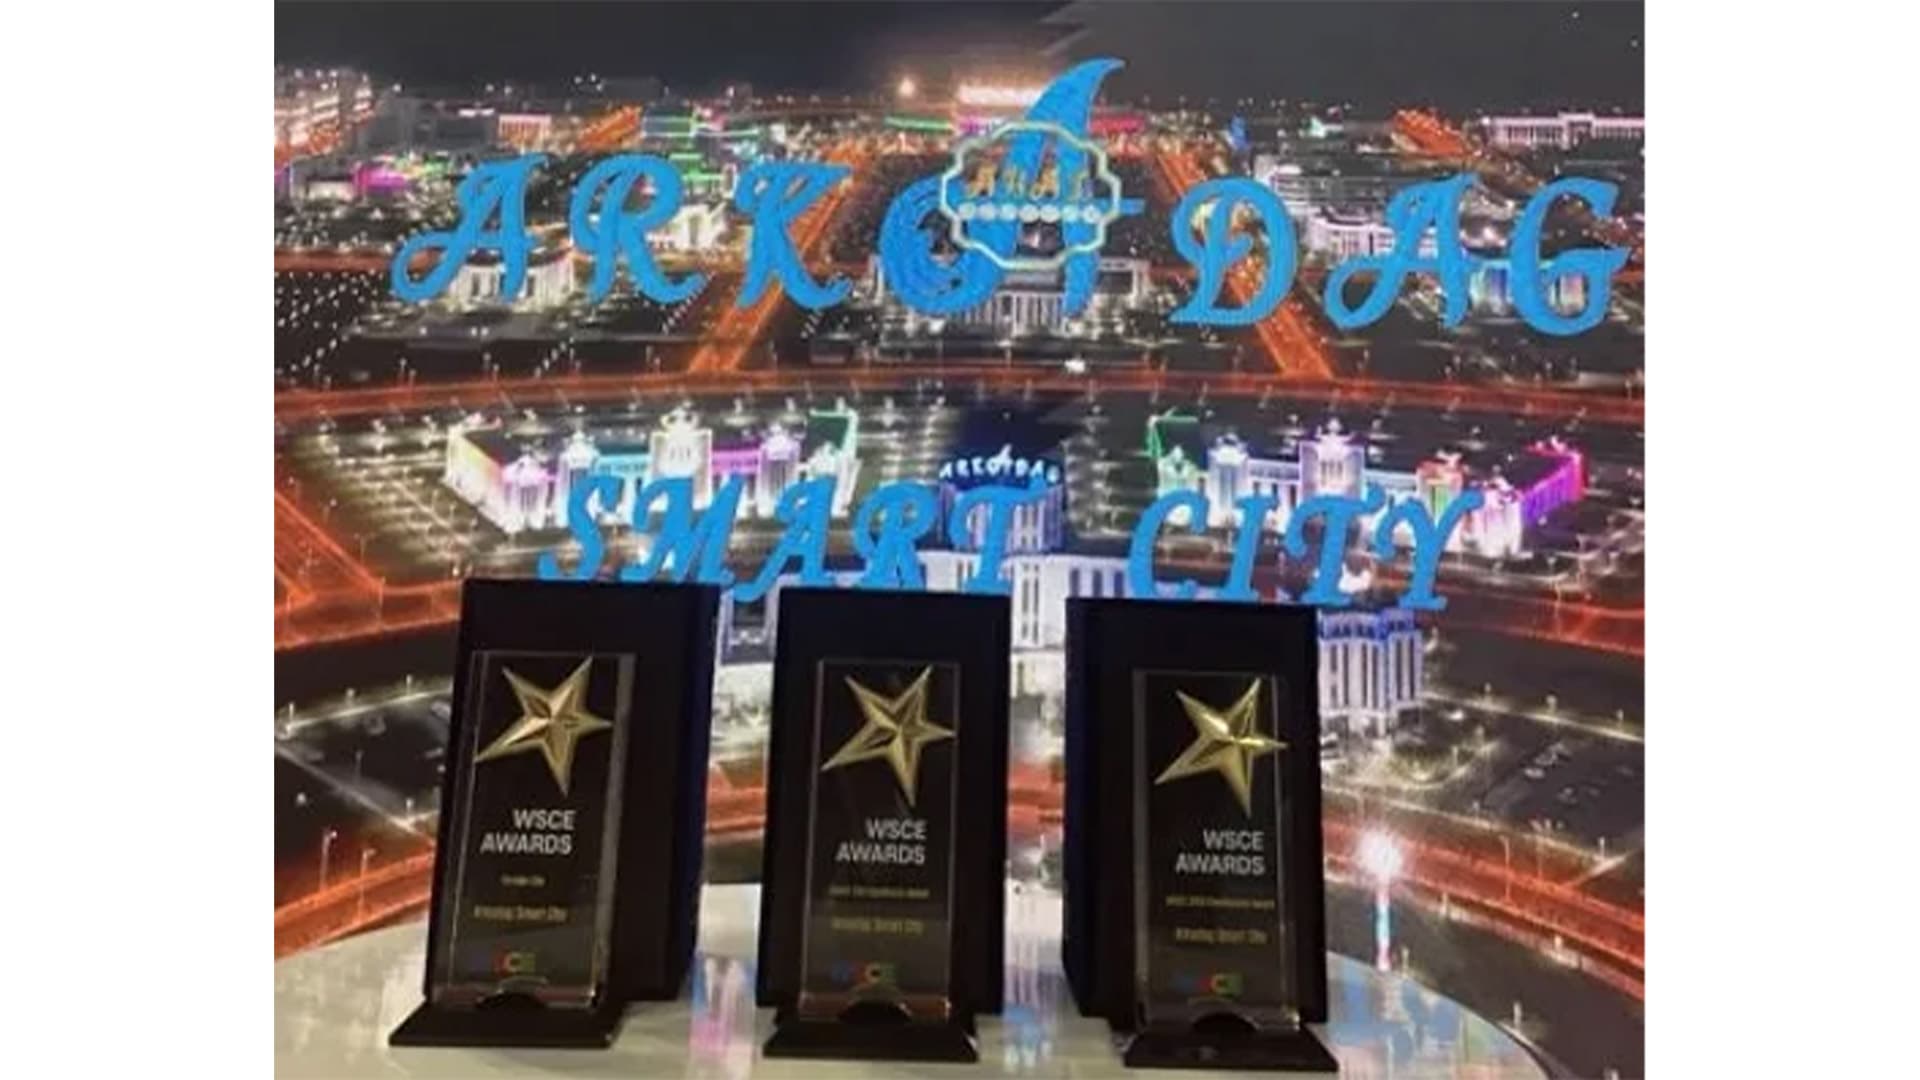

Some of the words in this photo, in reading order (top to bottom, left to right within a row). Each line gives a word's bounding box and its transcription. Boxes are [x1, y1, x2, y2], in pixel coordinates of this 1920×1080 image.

[537, 475, 1052, 602] SMART
[1127, 488, 1485, 611] CITY
[513, 808, 576, 831] WSCE
[866, 818, 927, 840] WSCE
[480, 832, 573, 856] AWARDS
[1203, 829, 1264, 851] WSCE
[836, 841, 926, 865] AWARDS
[1176, 853, 1266, 875] AWARDS
